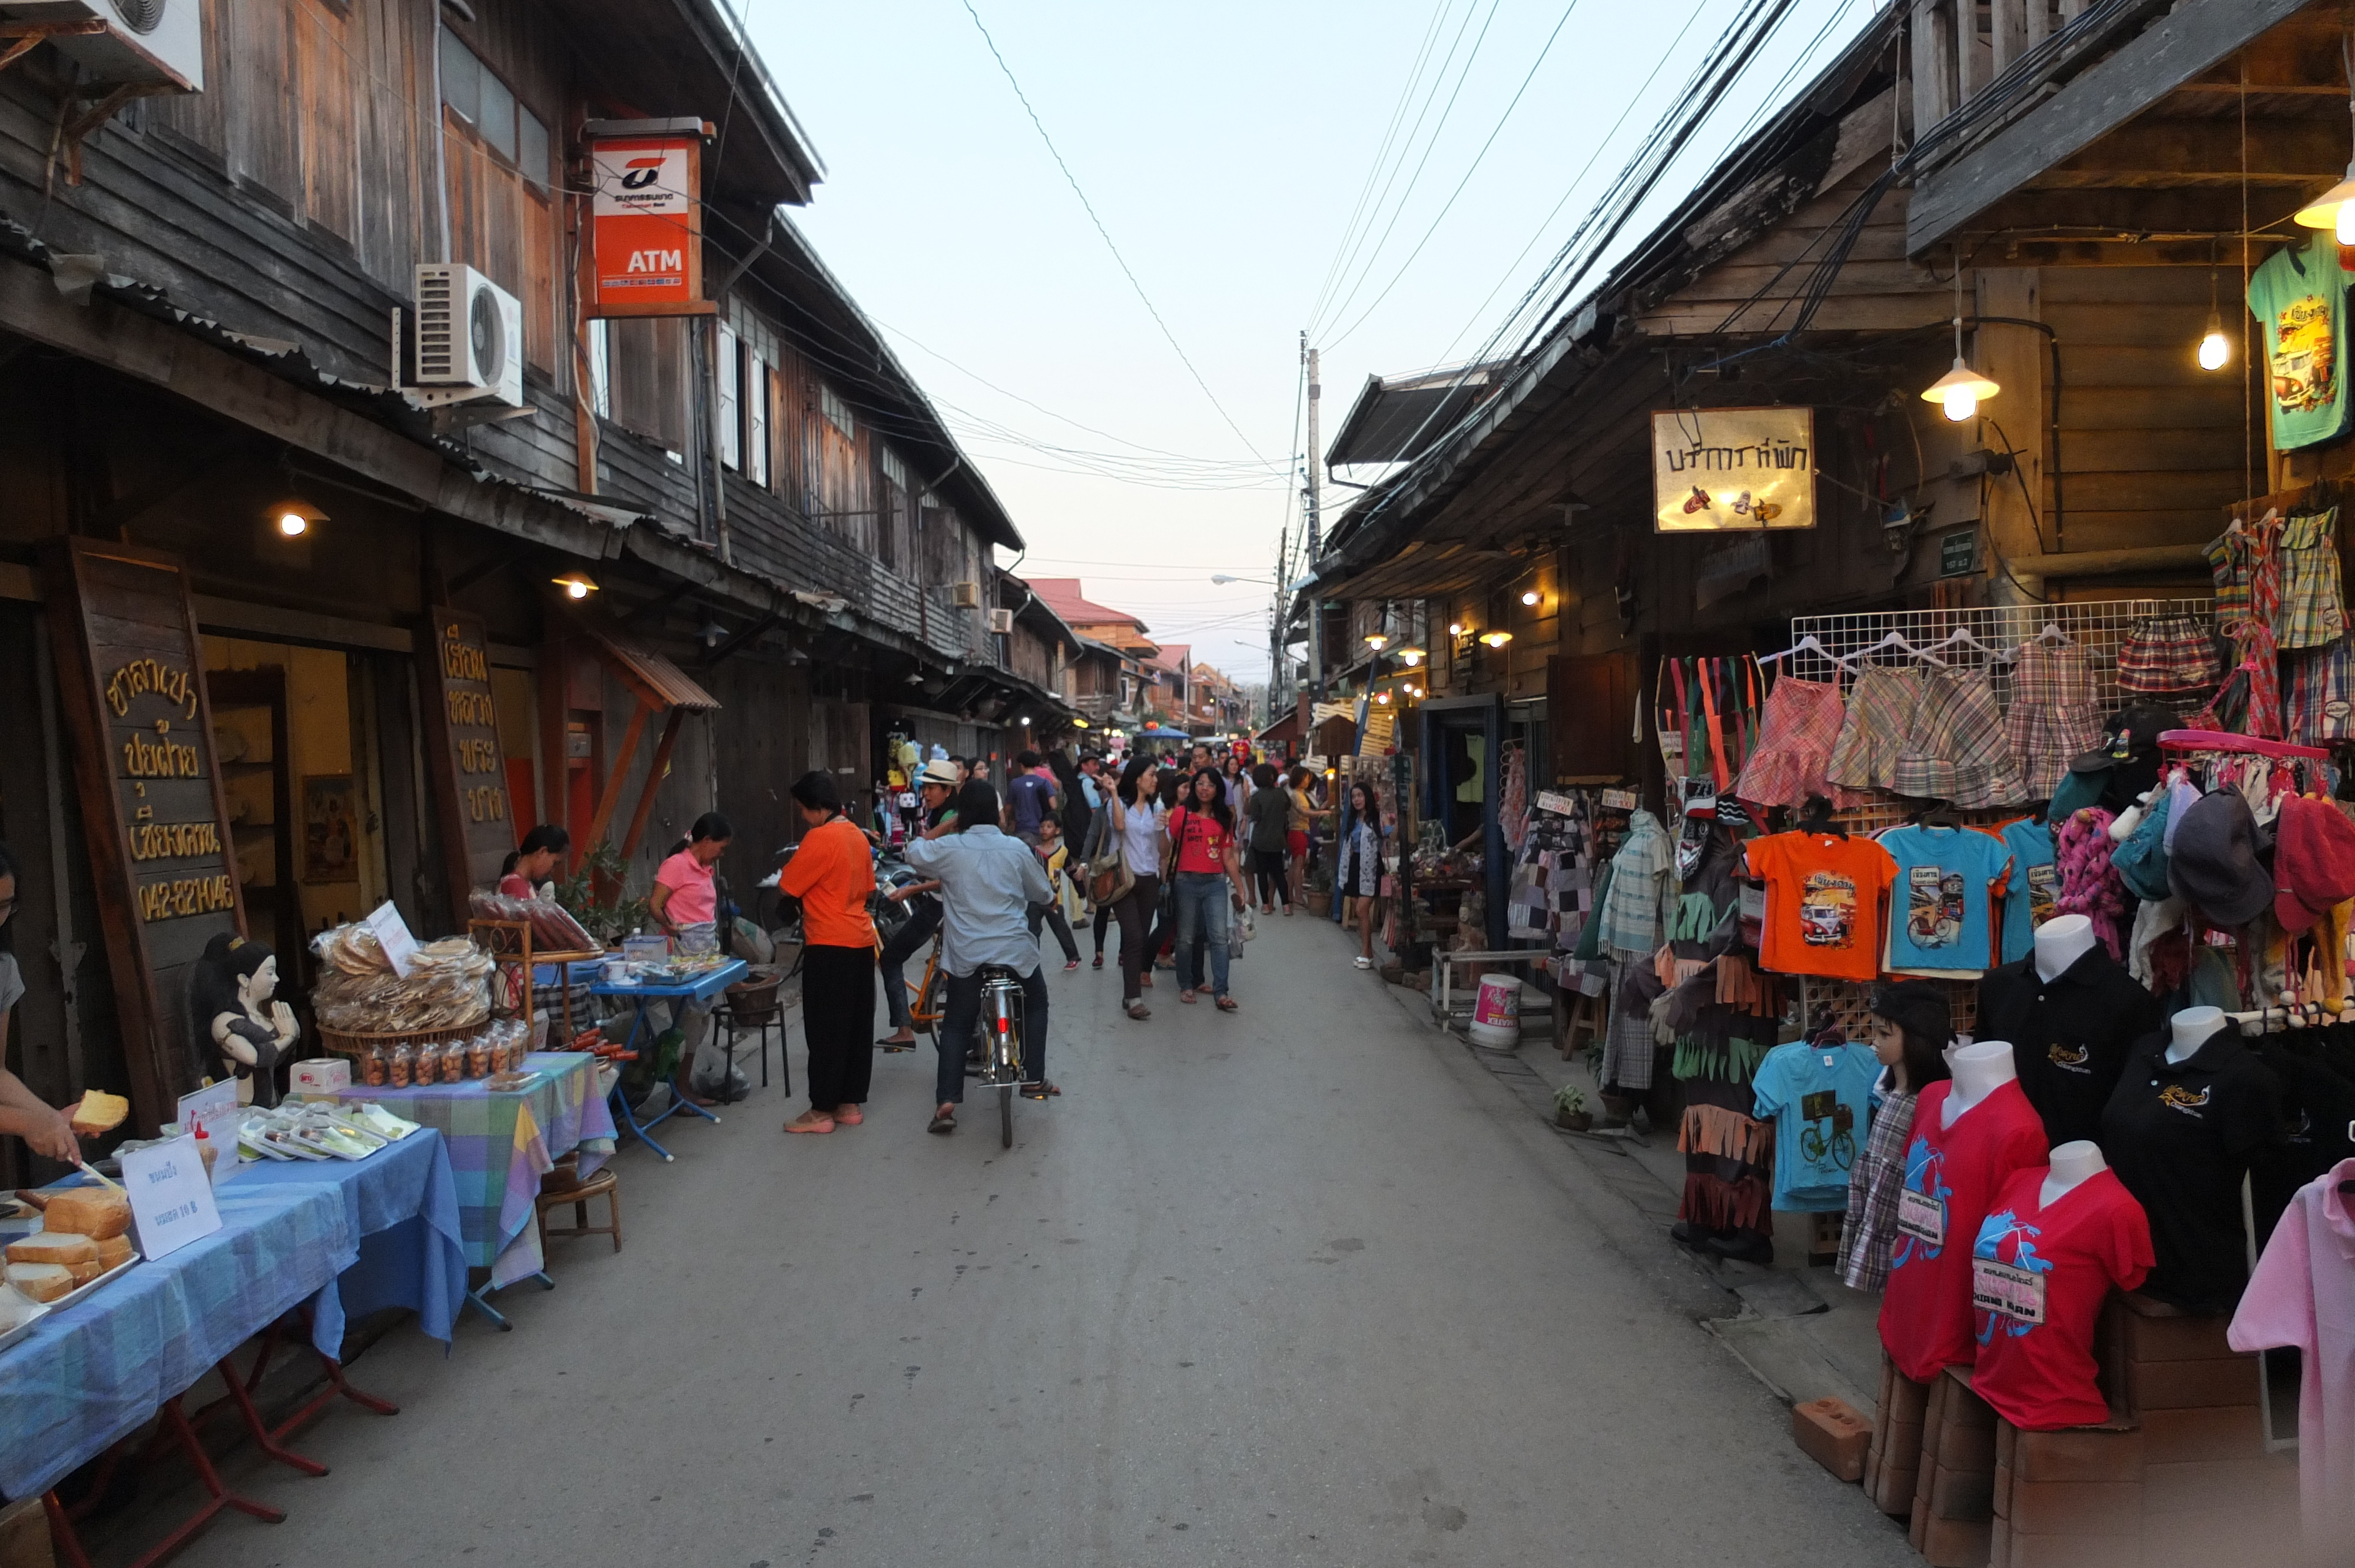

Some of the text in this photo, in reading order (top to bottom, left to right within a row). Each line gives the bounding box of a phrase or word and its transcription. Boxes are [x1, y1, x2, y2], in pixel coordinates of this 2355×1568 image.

[628, 250, 682, 273] ATM
[107, 658, 198, 720] ซาลาเปา
[459, 739, 496, 773] พระ
[139, 875, 234, 921] 042-821-046
[180, 1204, 190, 1217] 10
